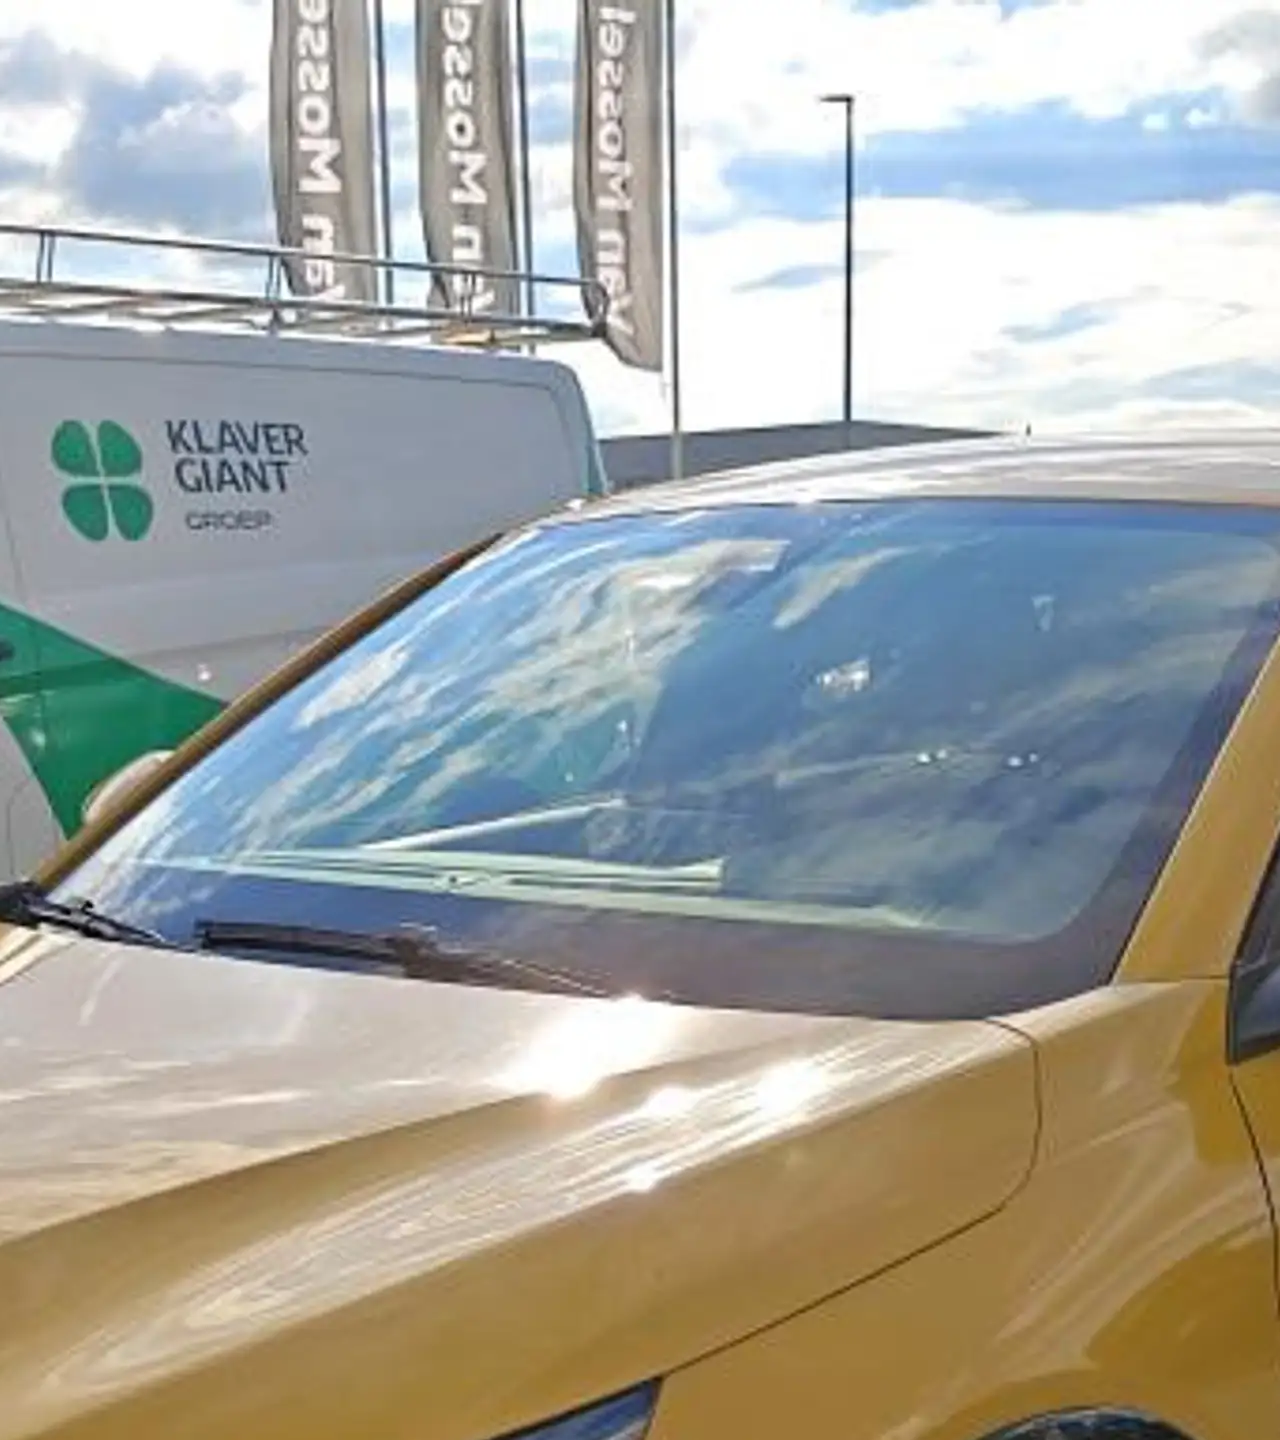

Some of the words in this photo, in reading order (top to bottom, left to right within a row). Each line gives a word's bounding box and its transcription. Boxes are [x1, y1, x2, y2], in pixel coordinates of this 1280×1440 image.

[165, 419, 308, 455] KLAVER
[175, 457, 293, 493] GIANT
[184, 510, 274, 530] GROEP
